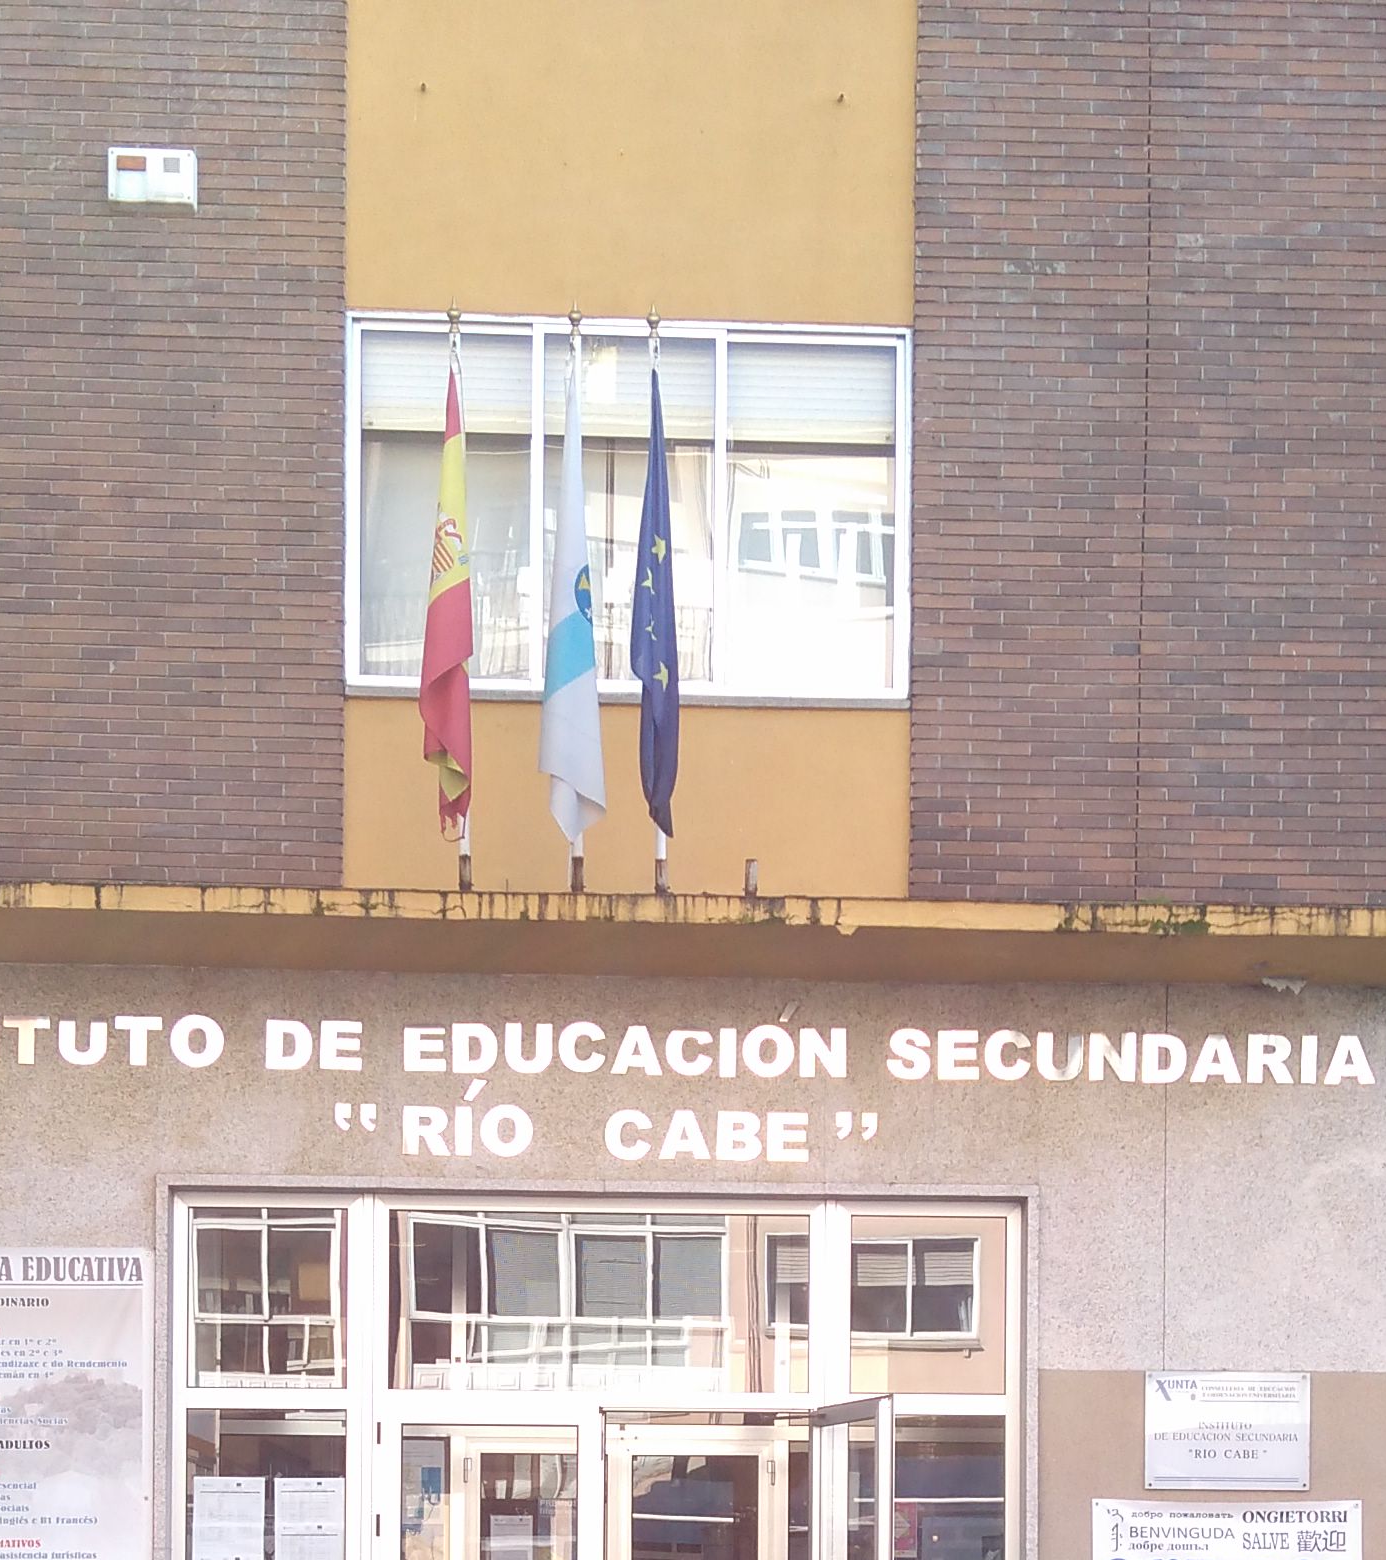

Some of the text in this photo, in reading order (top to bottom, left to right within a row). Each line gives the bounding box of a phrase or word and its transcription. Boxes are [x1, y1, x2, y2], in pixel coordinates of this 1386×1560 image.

[265, 1019, 363, 1071] DE
[403, 1004, 848, 1077] EDUCACIÓN
[887, 1027, 1375, 1085] SECUNDARIA
[22, 1256, 143, 1282] EDUCATIVA
[1155, 1379, 1198, 1401] XUNTA
[1198, 1421, 1253, 1430] INSTITUTO
[1154, 1432, 1169, 1441] DE
[1235, 1433, 1299, 1442] SECUNDARIA
[1131, 1511, 1234, 1519] добро пожаловать
[1242, 1510, 1348, 1523] ONGIETORRI
[1129, 1526, 1235, 1539] BENVINGUDA
[1128, 1542, 1164, 1552] добре
[1242, 1532, 1289, 1550] SALVE
[0, 1551, 48, 1560] asistencia
